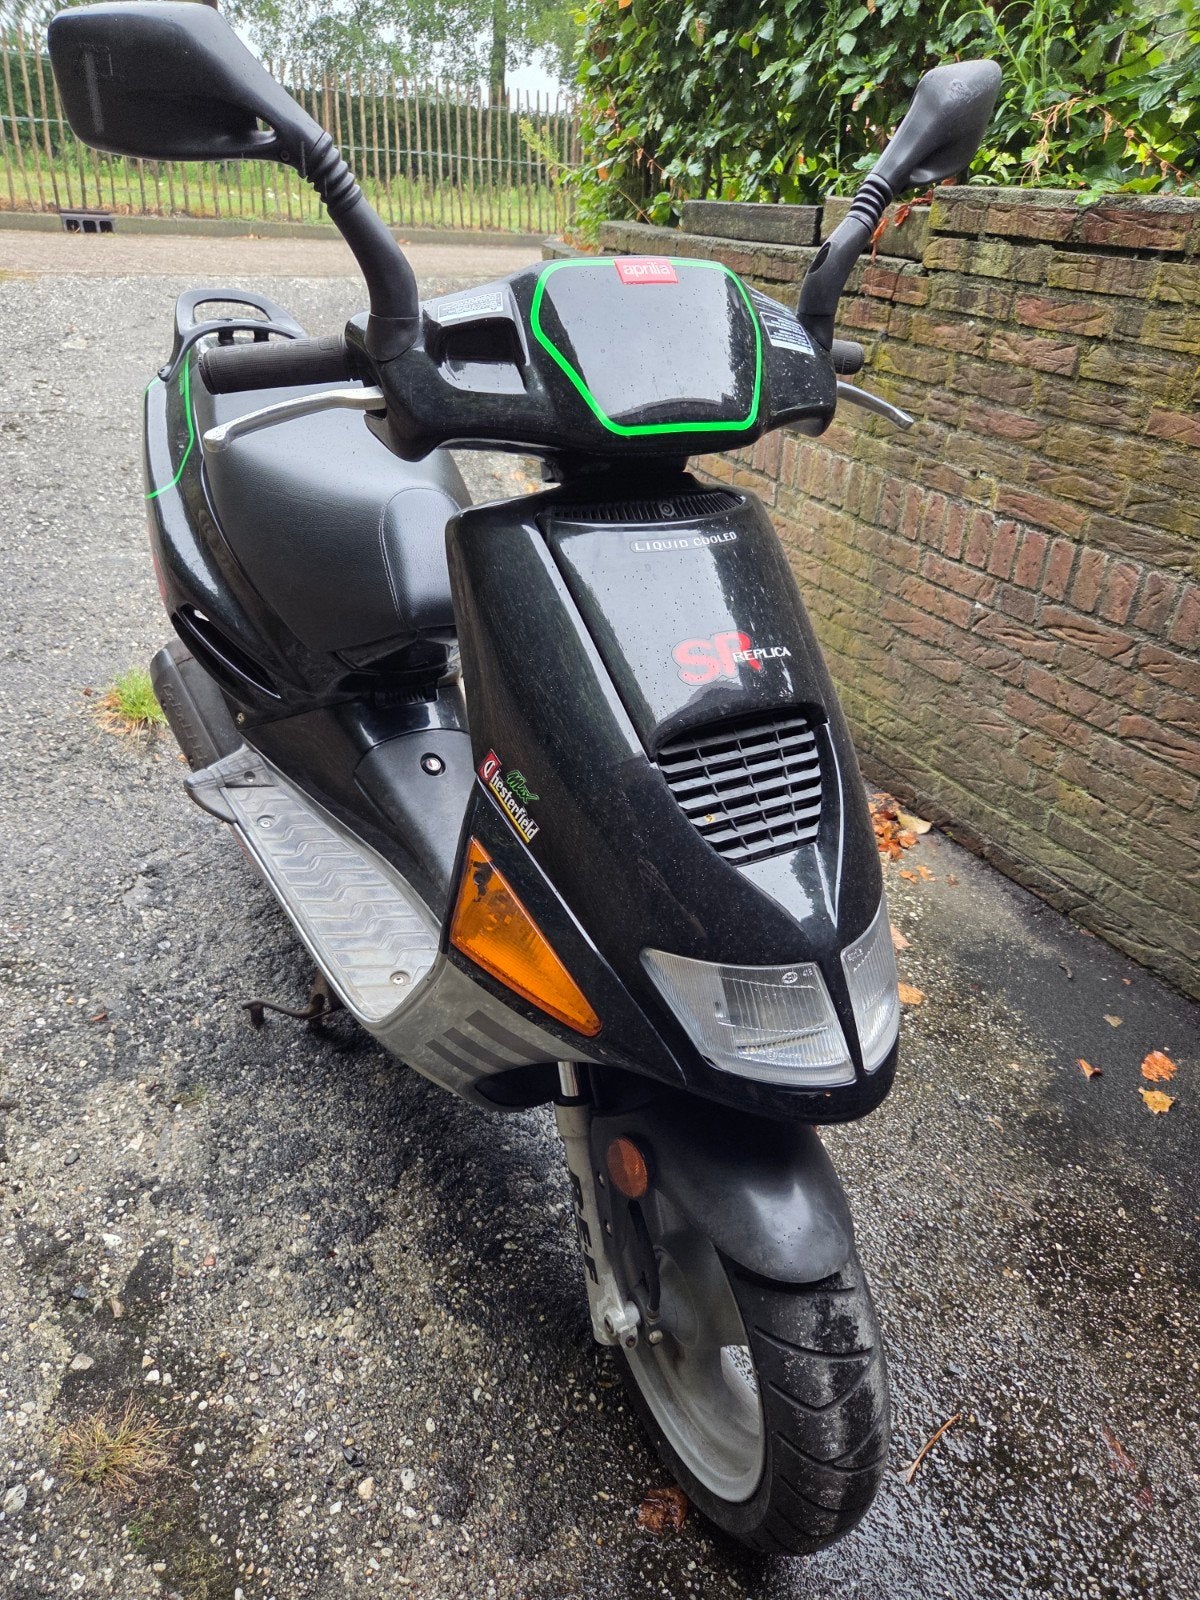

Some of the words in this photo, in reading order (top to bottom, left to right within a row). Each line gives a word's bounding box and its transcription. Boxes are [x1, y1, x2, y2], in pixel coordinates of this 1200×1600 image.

[623, 262, 671, 277] aprilia
[634, 539, 689, 552] LIQUID
[693, 531, 738, 547] COOLED
[673, 631, 763, 685] SR
[732, 646, 792, 663] REPLICA
[482, 758, 541, 840] Chesterfield
